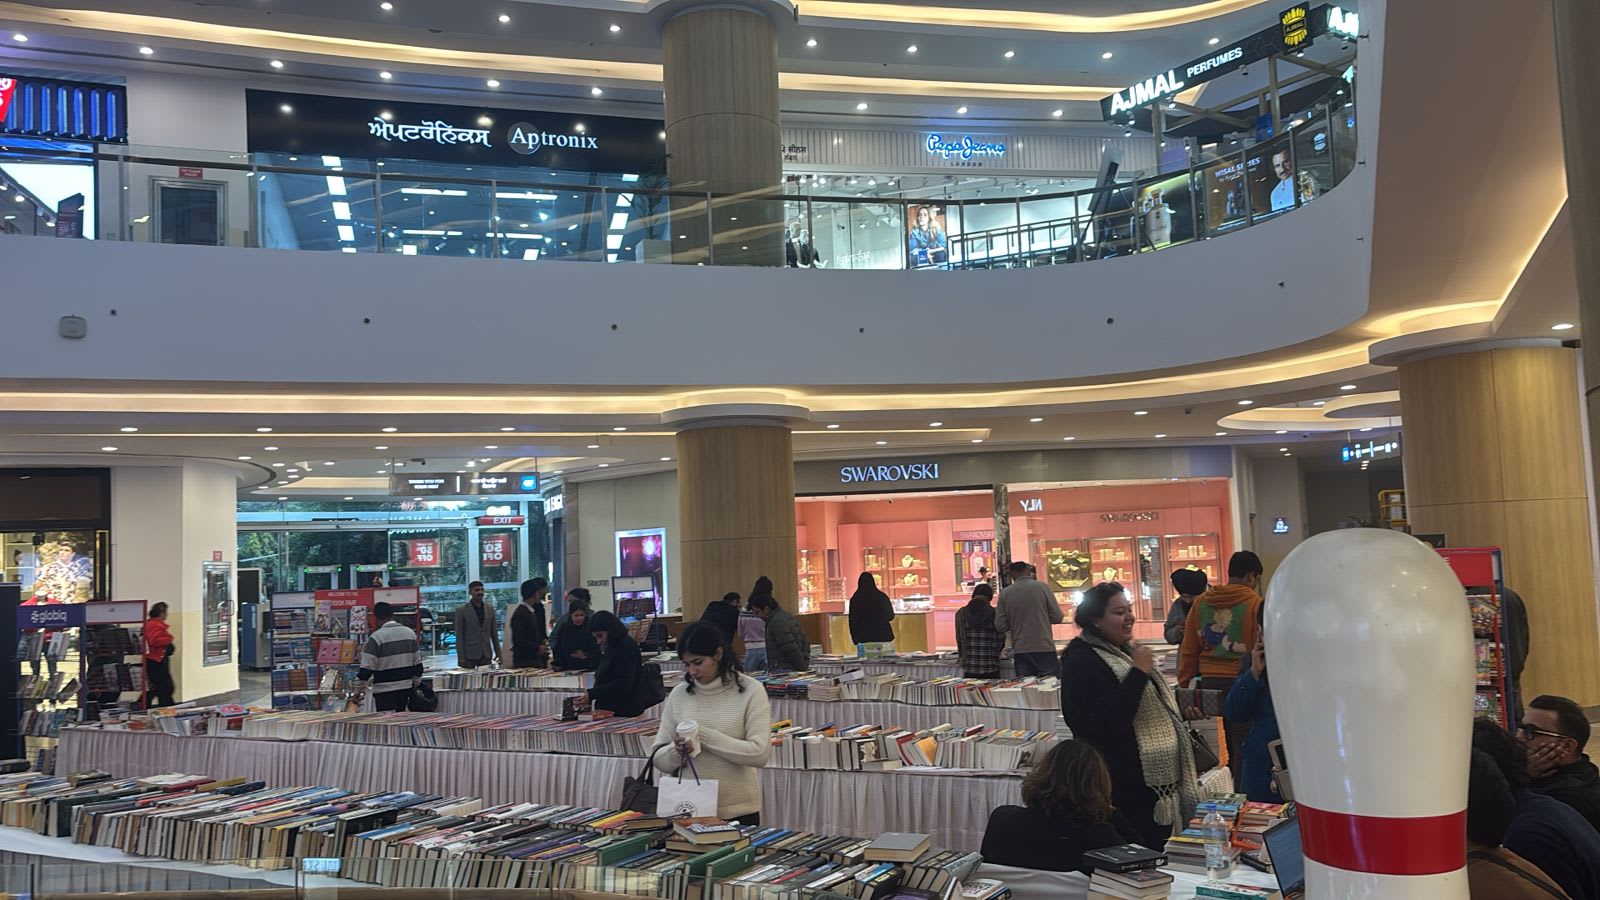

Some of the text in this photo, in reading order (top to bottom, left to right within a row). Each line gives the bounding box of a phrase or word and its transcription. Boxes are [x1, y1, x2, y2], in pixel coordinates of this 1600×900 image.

[1110, 47, 1243, 116] AJMAL PERFUMES
[510, 127, 599, 150] Aptronix
[926, 133, 1006, 160] Pepe Jeans
[841, 463, 940, 483] SWAROVSKI
[493, 516, 512, 525] EXIT
